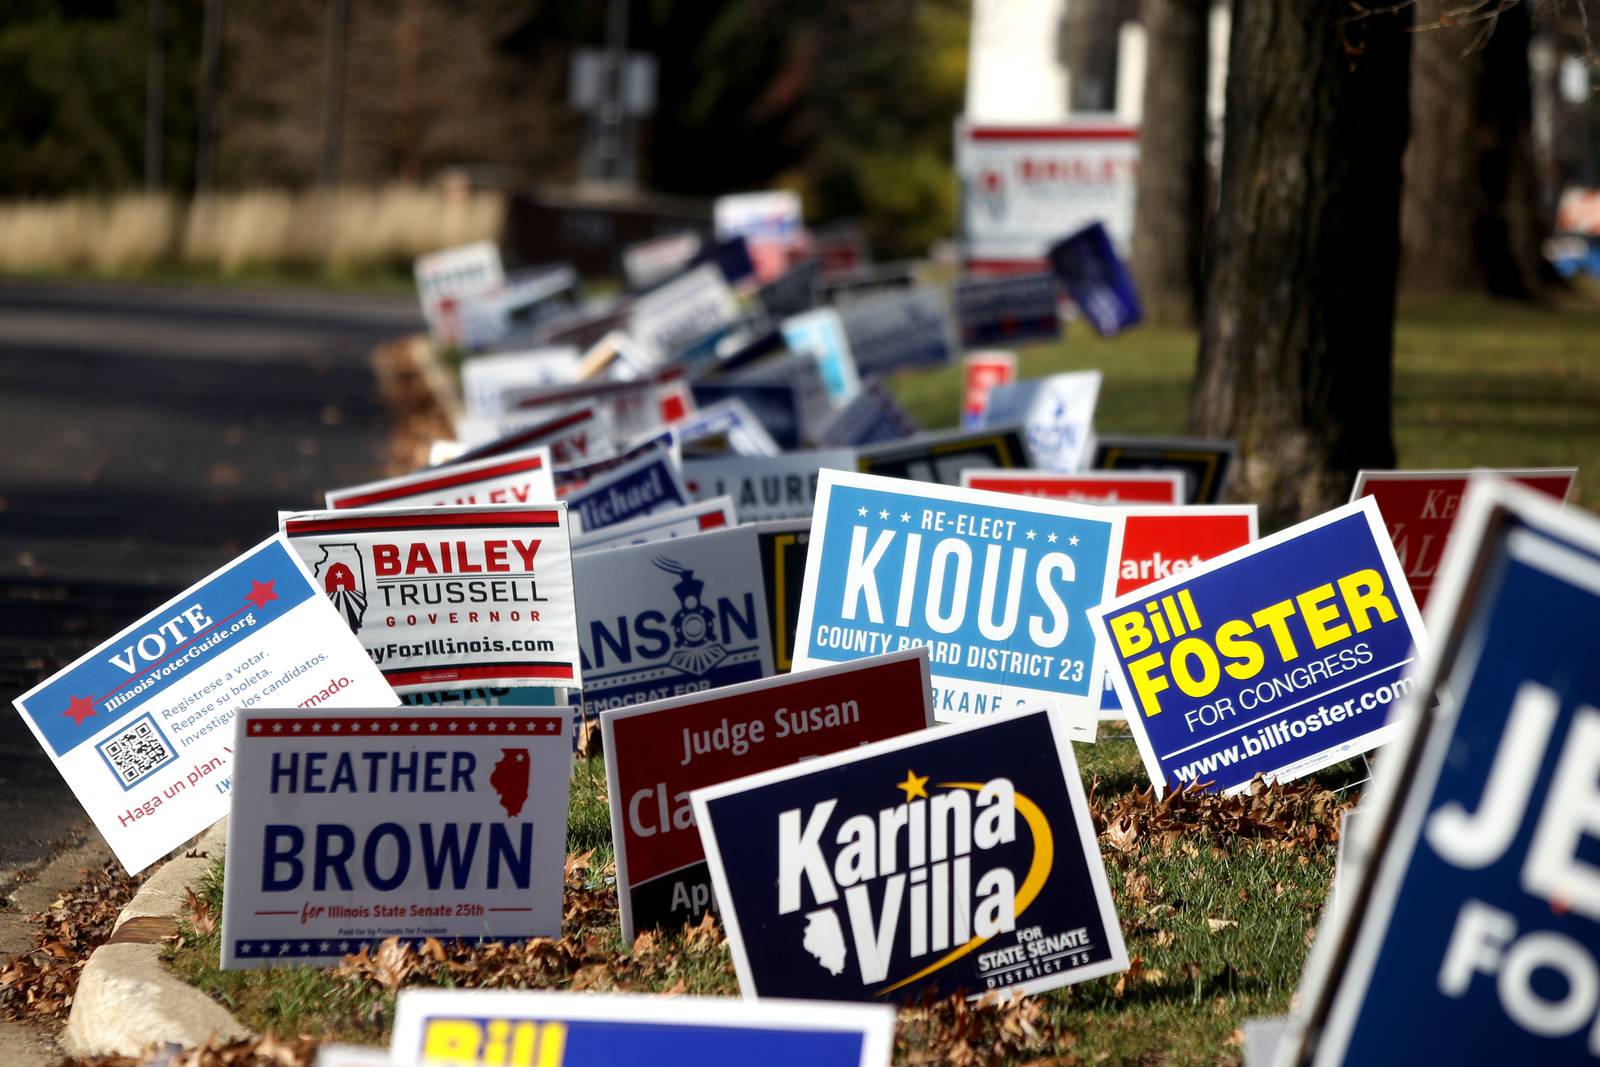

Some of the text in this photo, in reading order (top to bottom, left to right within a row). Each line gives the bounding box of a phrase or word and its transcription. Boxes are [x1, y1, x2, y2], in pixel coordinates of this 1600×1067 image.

[371, 539, 542, 577] BAILEY
[921, 509, 1016, 541] RE-ELECT
[377, 579, 548, 607] TRUSSELL
[386, 611, 541, 628] GOVERNOR
[841, 525, 1077, 649] KIOUS
[108, 604, 213, 674] VOTE
[816, 624, 892, 656] COUNTY
[967, 647, 1054, 679] DISTRICT
[1059, 658, 1085, 682] 23
[1109, 589, 1202, 659] Bill
[1126, 568, 1399, 719] FOSTER
[104, 612, 257, 712] IllinoisVoterGuide.org
[161, 651, 270, 720] Registrese a votar.
[1184, 642, 1374, 734] FOR CONGRESS
[171, 669, 273, 733] Repase su boleta.
[180, 653, 329, 747] Investigu los candidatos.
[680, 718, 765, 766] Judge
[774, 700, 860, 738] Susan
[1172, 675, 1415, 784] www.billfoster.com
[117, 757, 226, 828] Haga un plan.
[270, 751, 477, 794] HEATHER
[261, 822, 533, 893] BROWN
[778, 777, 1017, 916] Karina
[300, 902, 484, 925] for Illinois State Senate 25th
[845, 867, 1017, 986] Villa
[1016, 926, 1043, 943] FOR
[978, 927, 1090, 972] STATE SENATE
[986, 952, 1090, 988] DISTRICT 25
